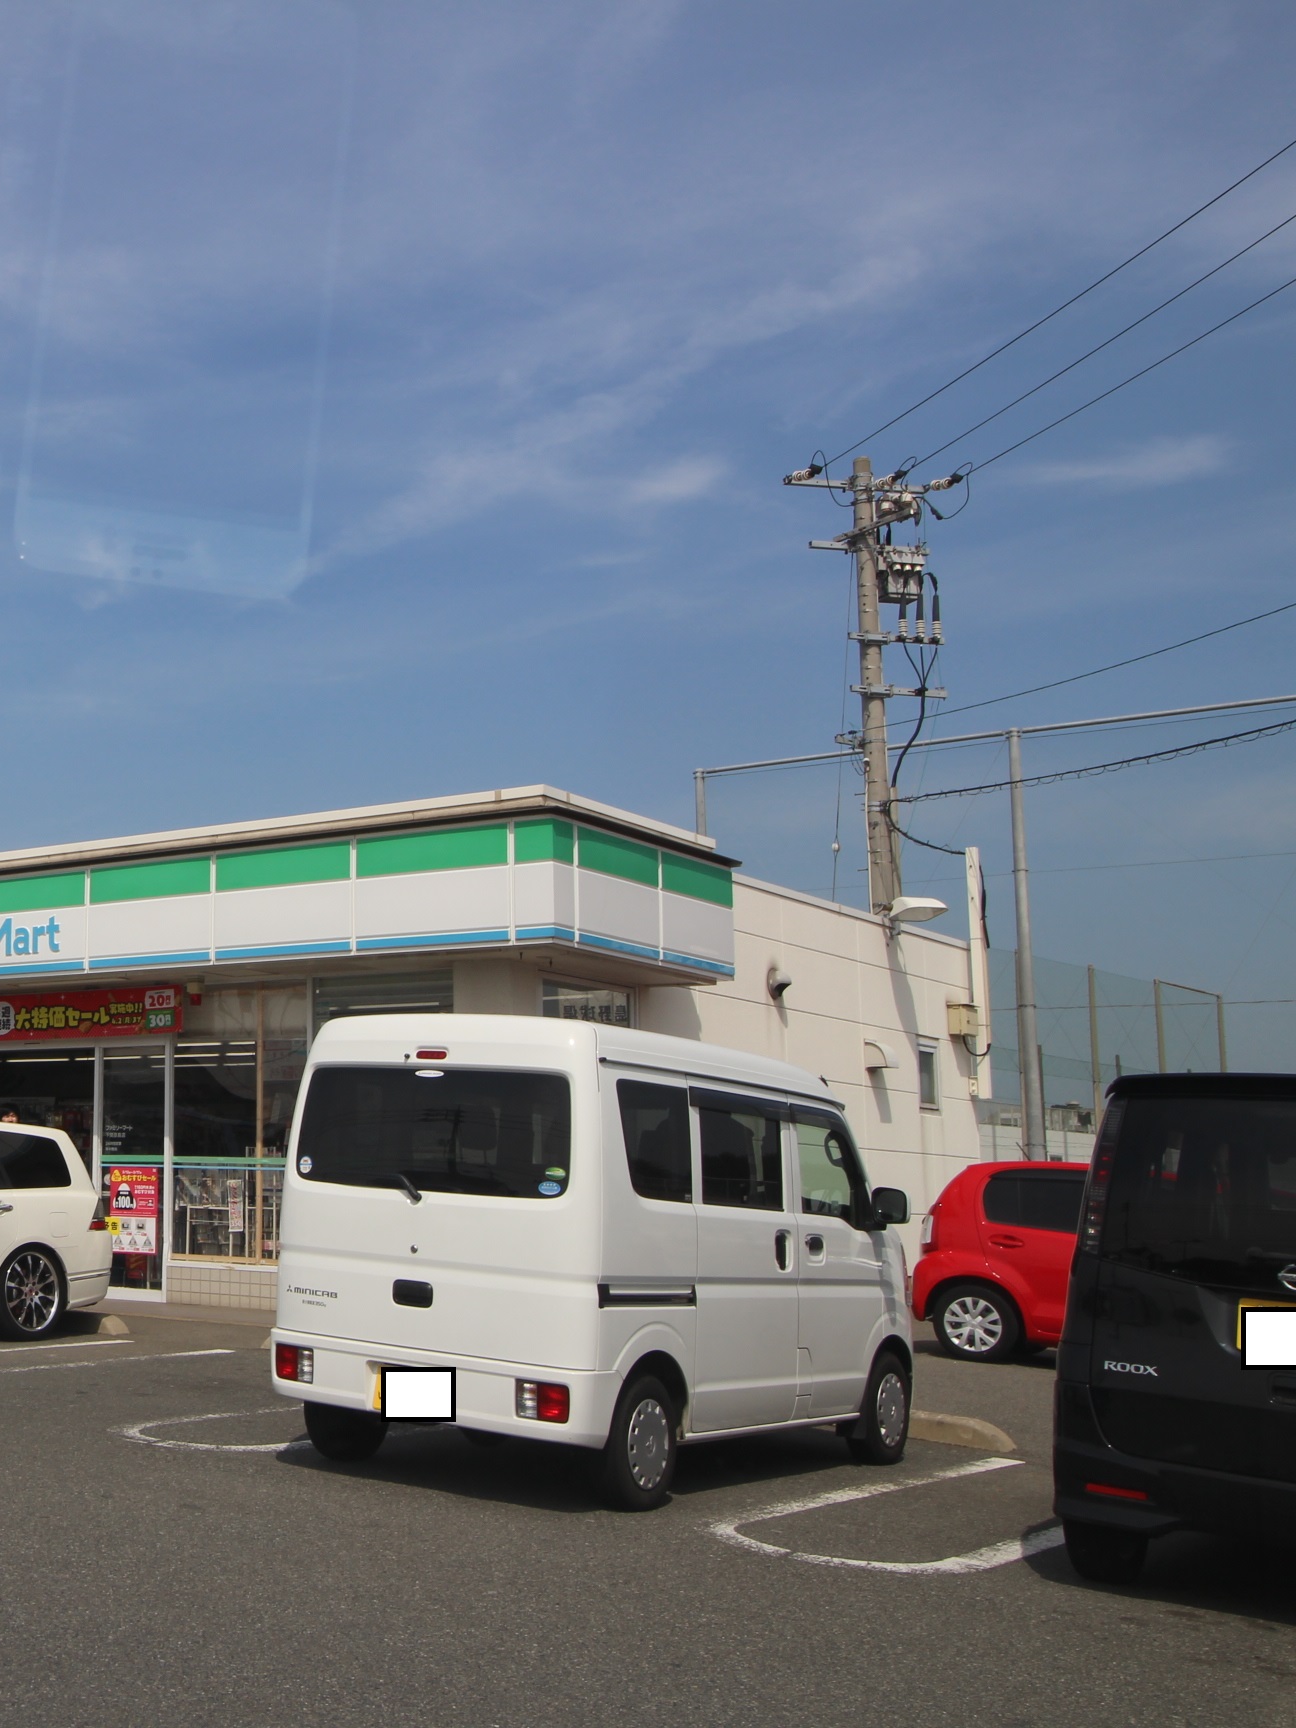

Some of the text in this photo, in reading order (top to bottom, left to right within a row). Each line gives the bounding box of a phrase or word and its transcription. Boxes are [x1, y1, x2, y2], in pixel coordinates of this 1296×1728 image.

[15, 1005, 111, 1031] 大特価セール
[294, 1286, 338, 1299] MINICAB
[1104, 1360, 1158, 1377] ROOX
